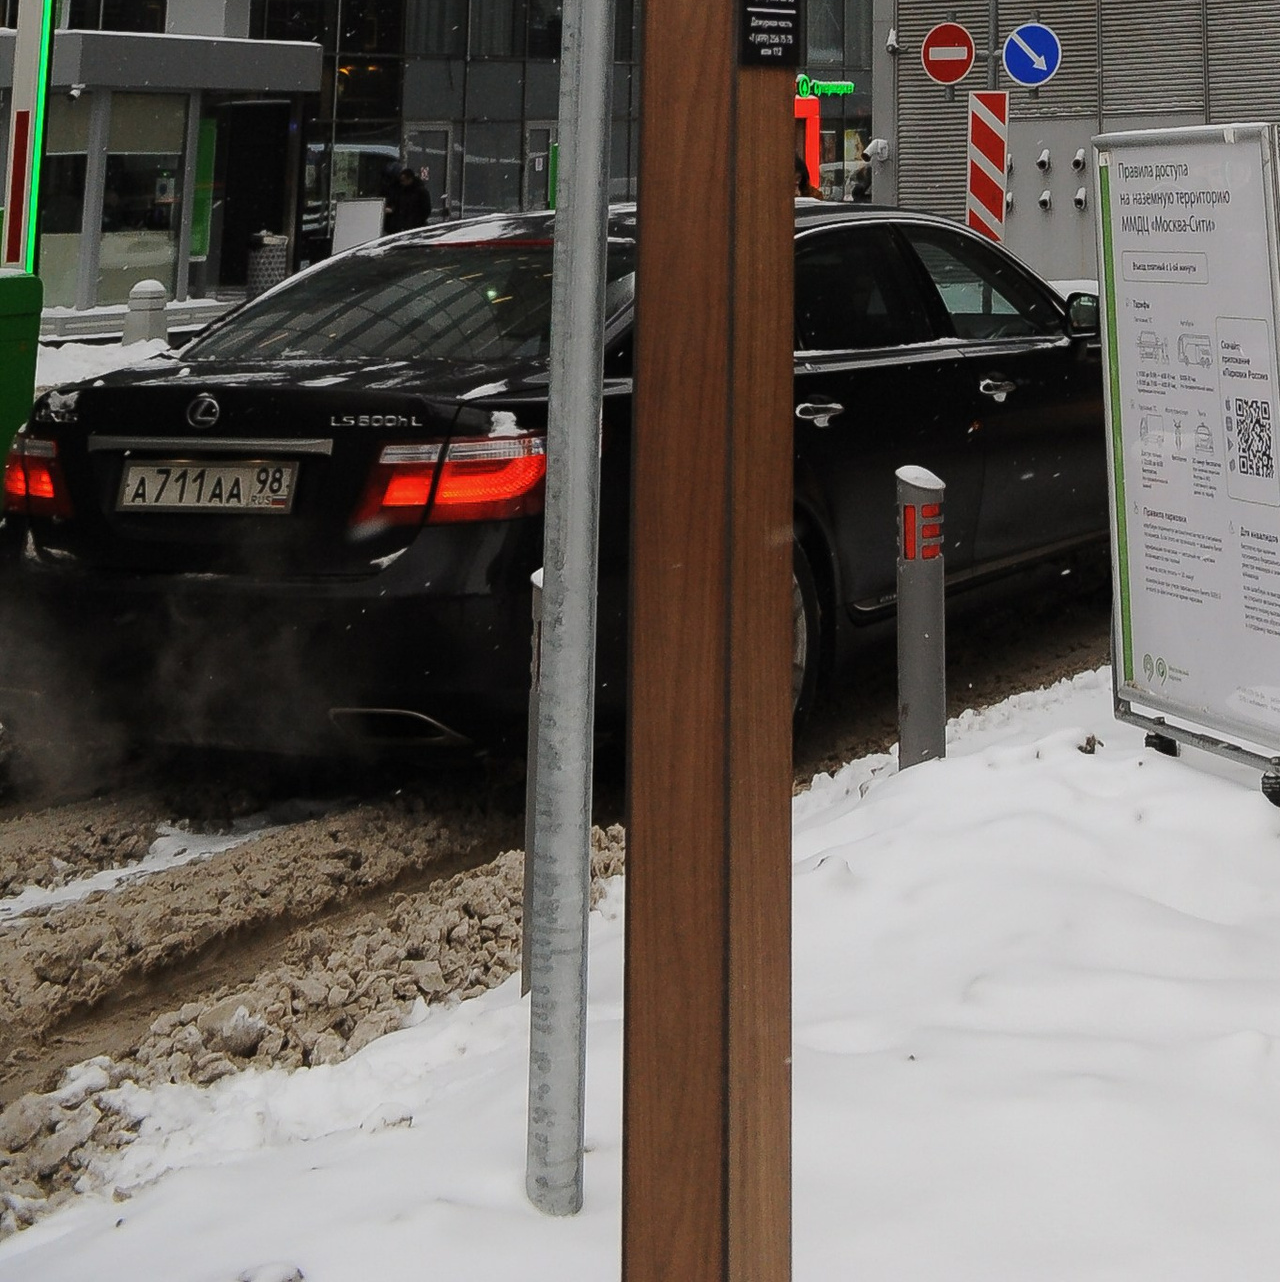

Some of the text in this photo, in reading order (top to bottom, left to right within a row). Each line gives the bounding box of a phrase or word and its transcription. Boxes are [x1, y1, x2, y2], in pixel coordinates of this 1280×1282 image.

[1118, 162, 1189, 182] Правила доступа
[1120, 190, 1230, 209] на наземную территорию
[1121, 215, 1216, 235] ММДЦ «Москва-Сити»
[131, 467, 283, 504] А711АА 98
[252, 495, 271, 506] RUS
